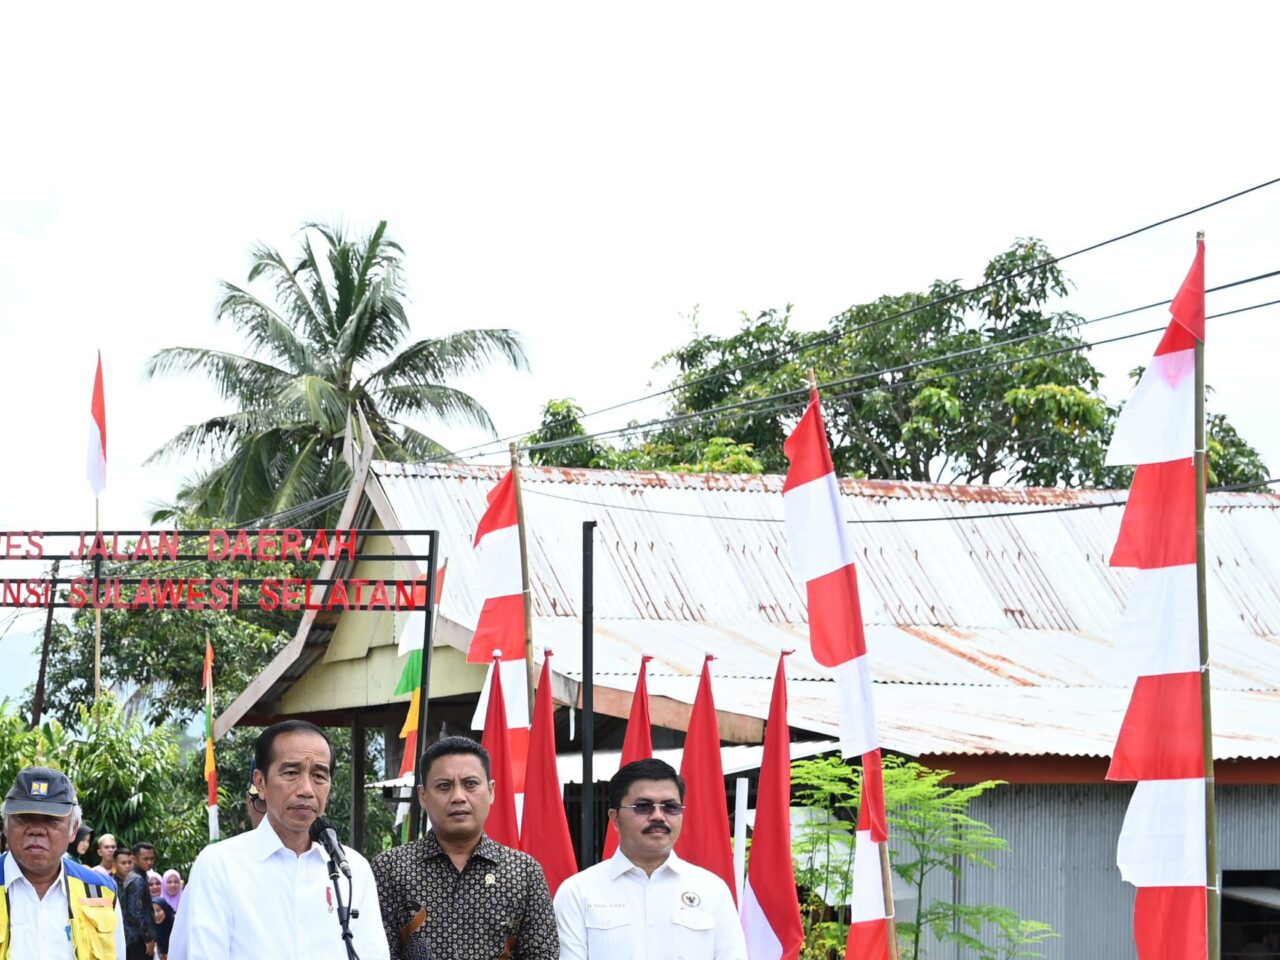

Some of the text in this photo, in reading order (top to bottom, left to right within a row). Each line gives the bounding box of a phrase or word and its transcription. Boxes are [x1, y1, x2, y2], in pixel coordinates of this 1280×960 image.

[69, 530, 179, 561] JALAN
[207, 528, 358, 561] DAERAH
[68, 577, 241, 611] SULAWESI
[258, 576, 417, 612] SELATAN
